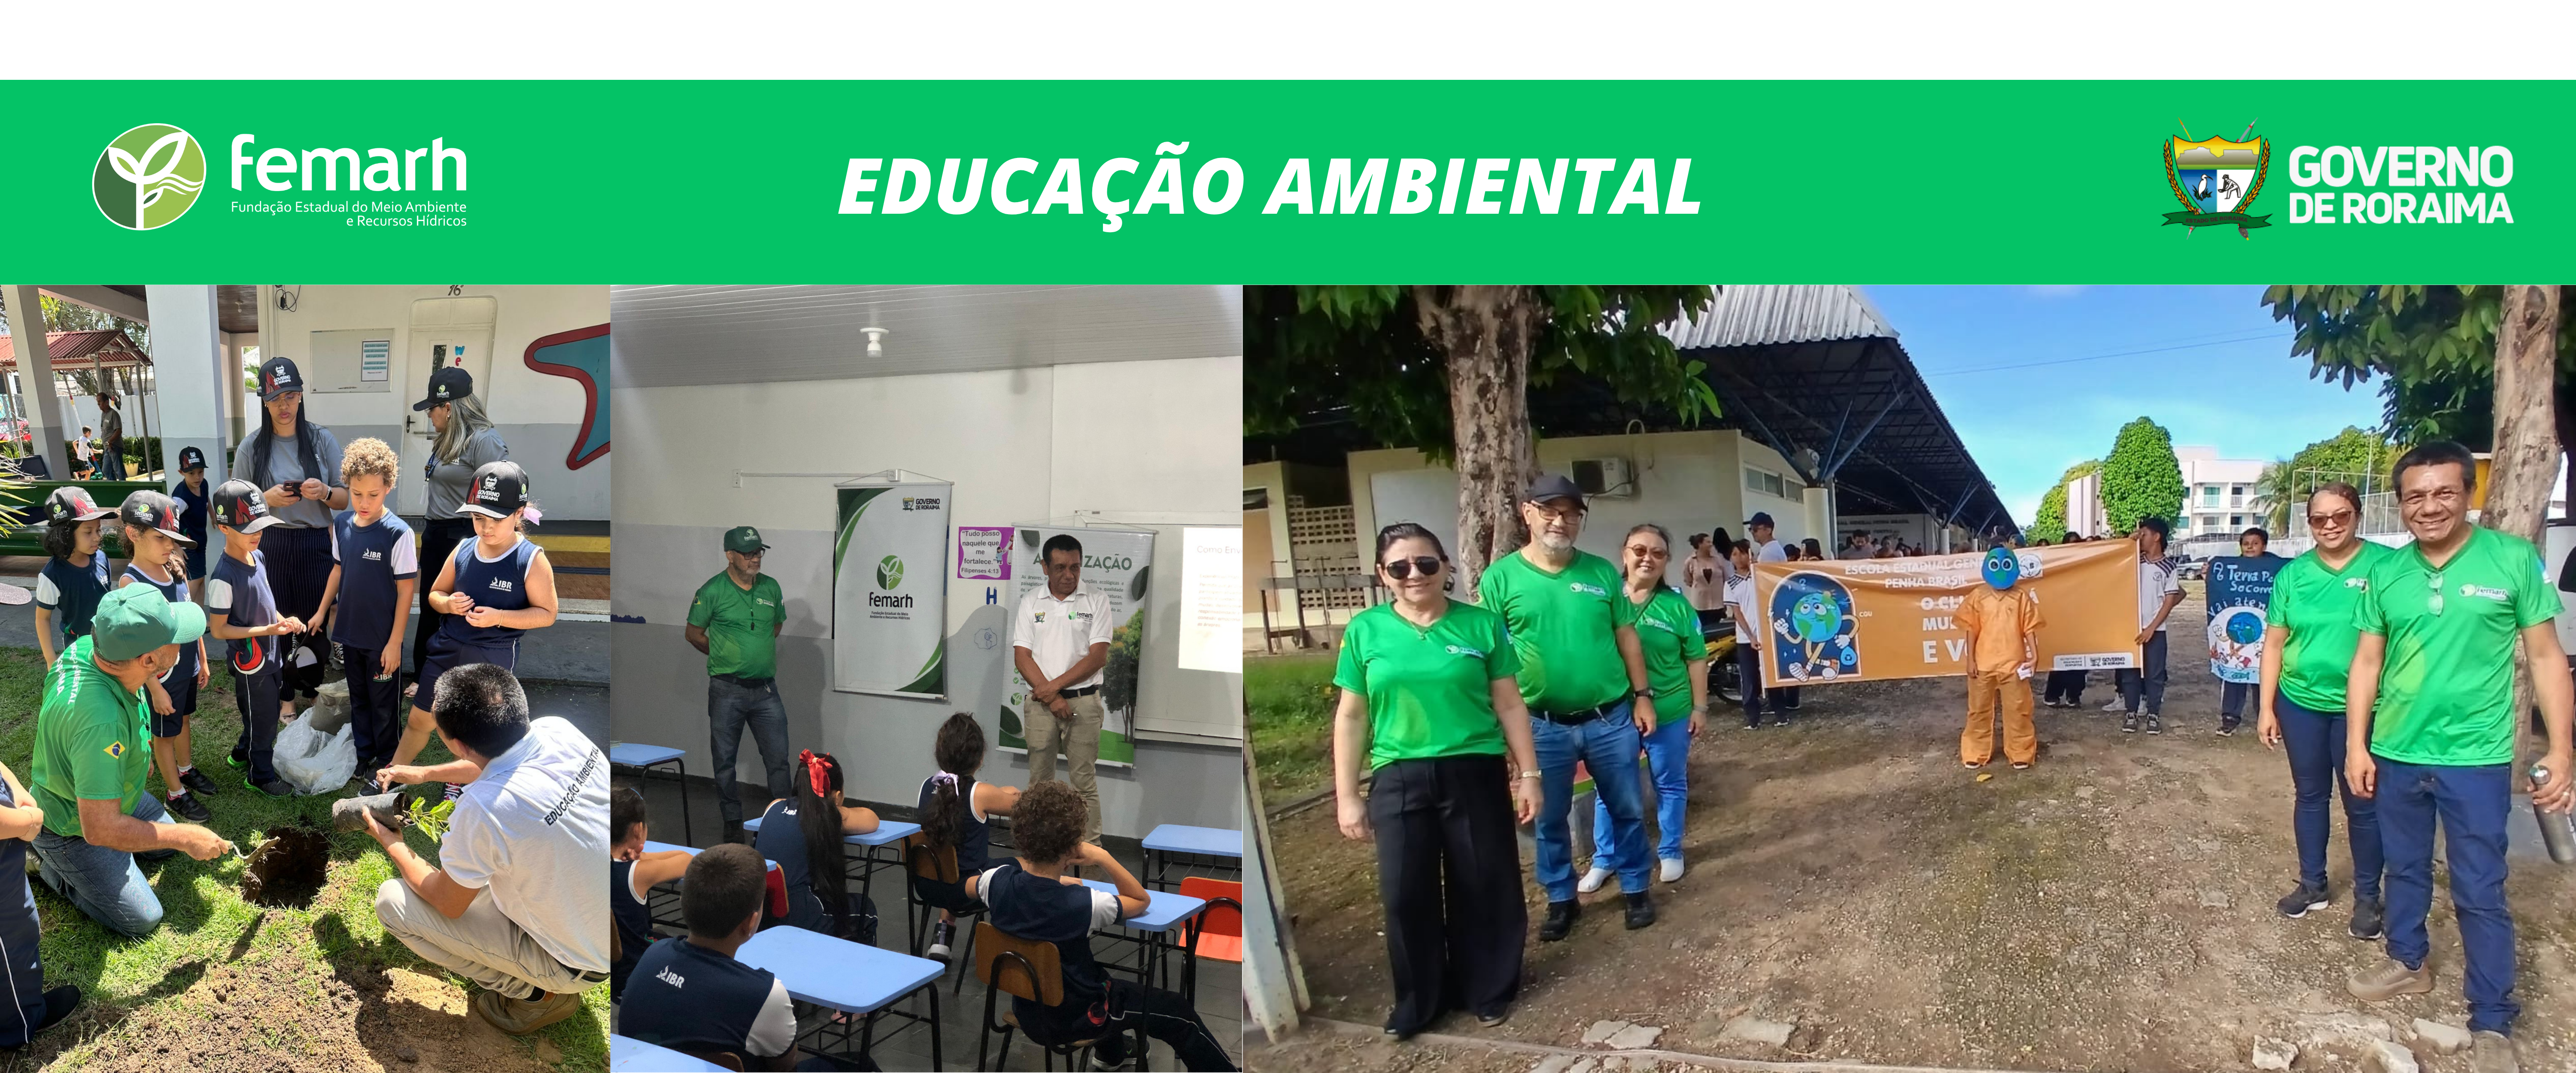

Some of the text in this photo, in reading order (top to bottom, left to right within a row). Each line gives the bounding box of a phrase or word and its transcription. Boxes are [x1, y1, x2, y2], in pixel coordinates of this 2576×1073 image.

[273, 375, 291, 383] GOVERNO
[134, 510, 153, 518] femarh
[1197, 546, 1223, 554] Como
[1845, 564, 1889, 574] ESCOLA
[1893, 561, 1951, 573] ESTADUAL
[2227, 564, 2258, 582] Terra
[498, 580, 512, 589] IBR
[1885, 575, 1967, 589] PENHA BRASIL
[869, 591, 913, 608] femarh
[986, 586, 997, 605] H
[1921, 597, 1934, 610] O
[1923, 640, 1938, 663] E
[544, 746, 599, 826] EDUCAÇÃO AMBIENTAL
[665, 972, 685, 988] IBR
